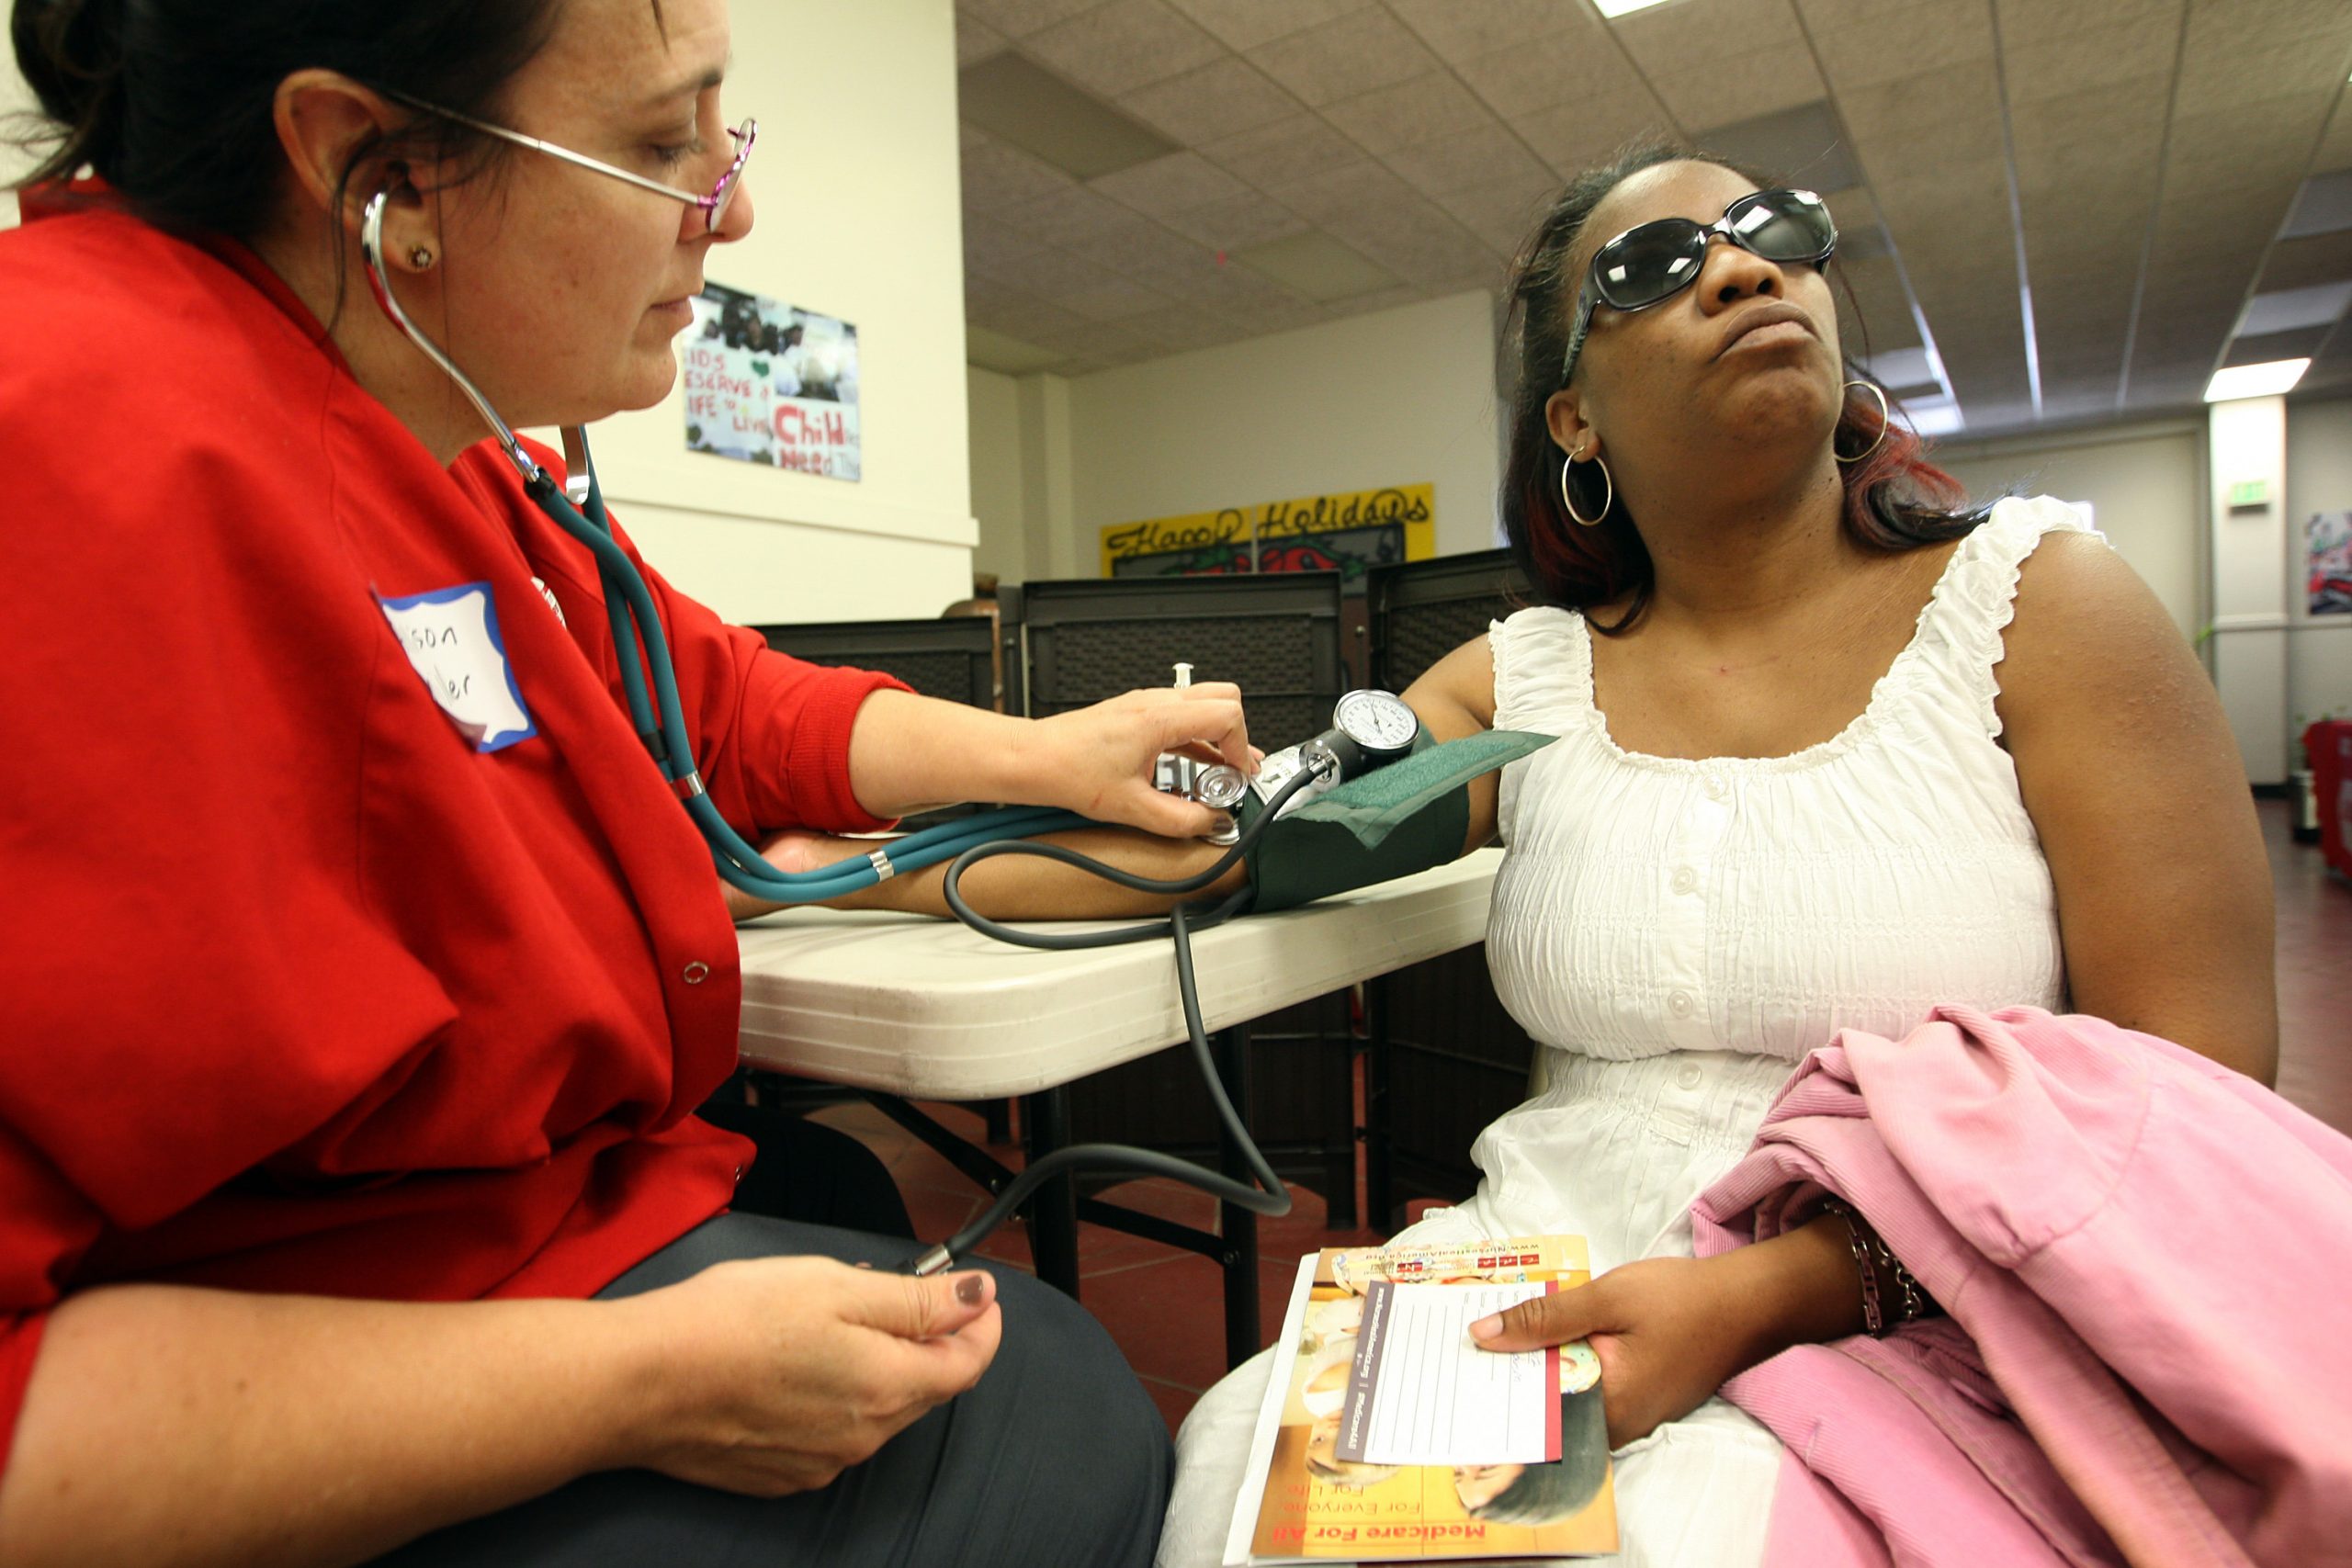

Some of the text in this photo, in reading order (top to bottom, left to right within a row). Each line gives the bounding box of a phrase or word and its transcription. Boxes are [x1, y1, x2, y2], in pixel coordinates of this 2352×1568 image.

[690, 349, 726, 372] IDS
[411, 625, 458, 649] son
[1385, 1502, 1421, 1515] For
[1315, 1527, 1358, 1541] For
[1366, 1525, 1487, 1541] Medicare
